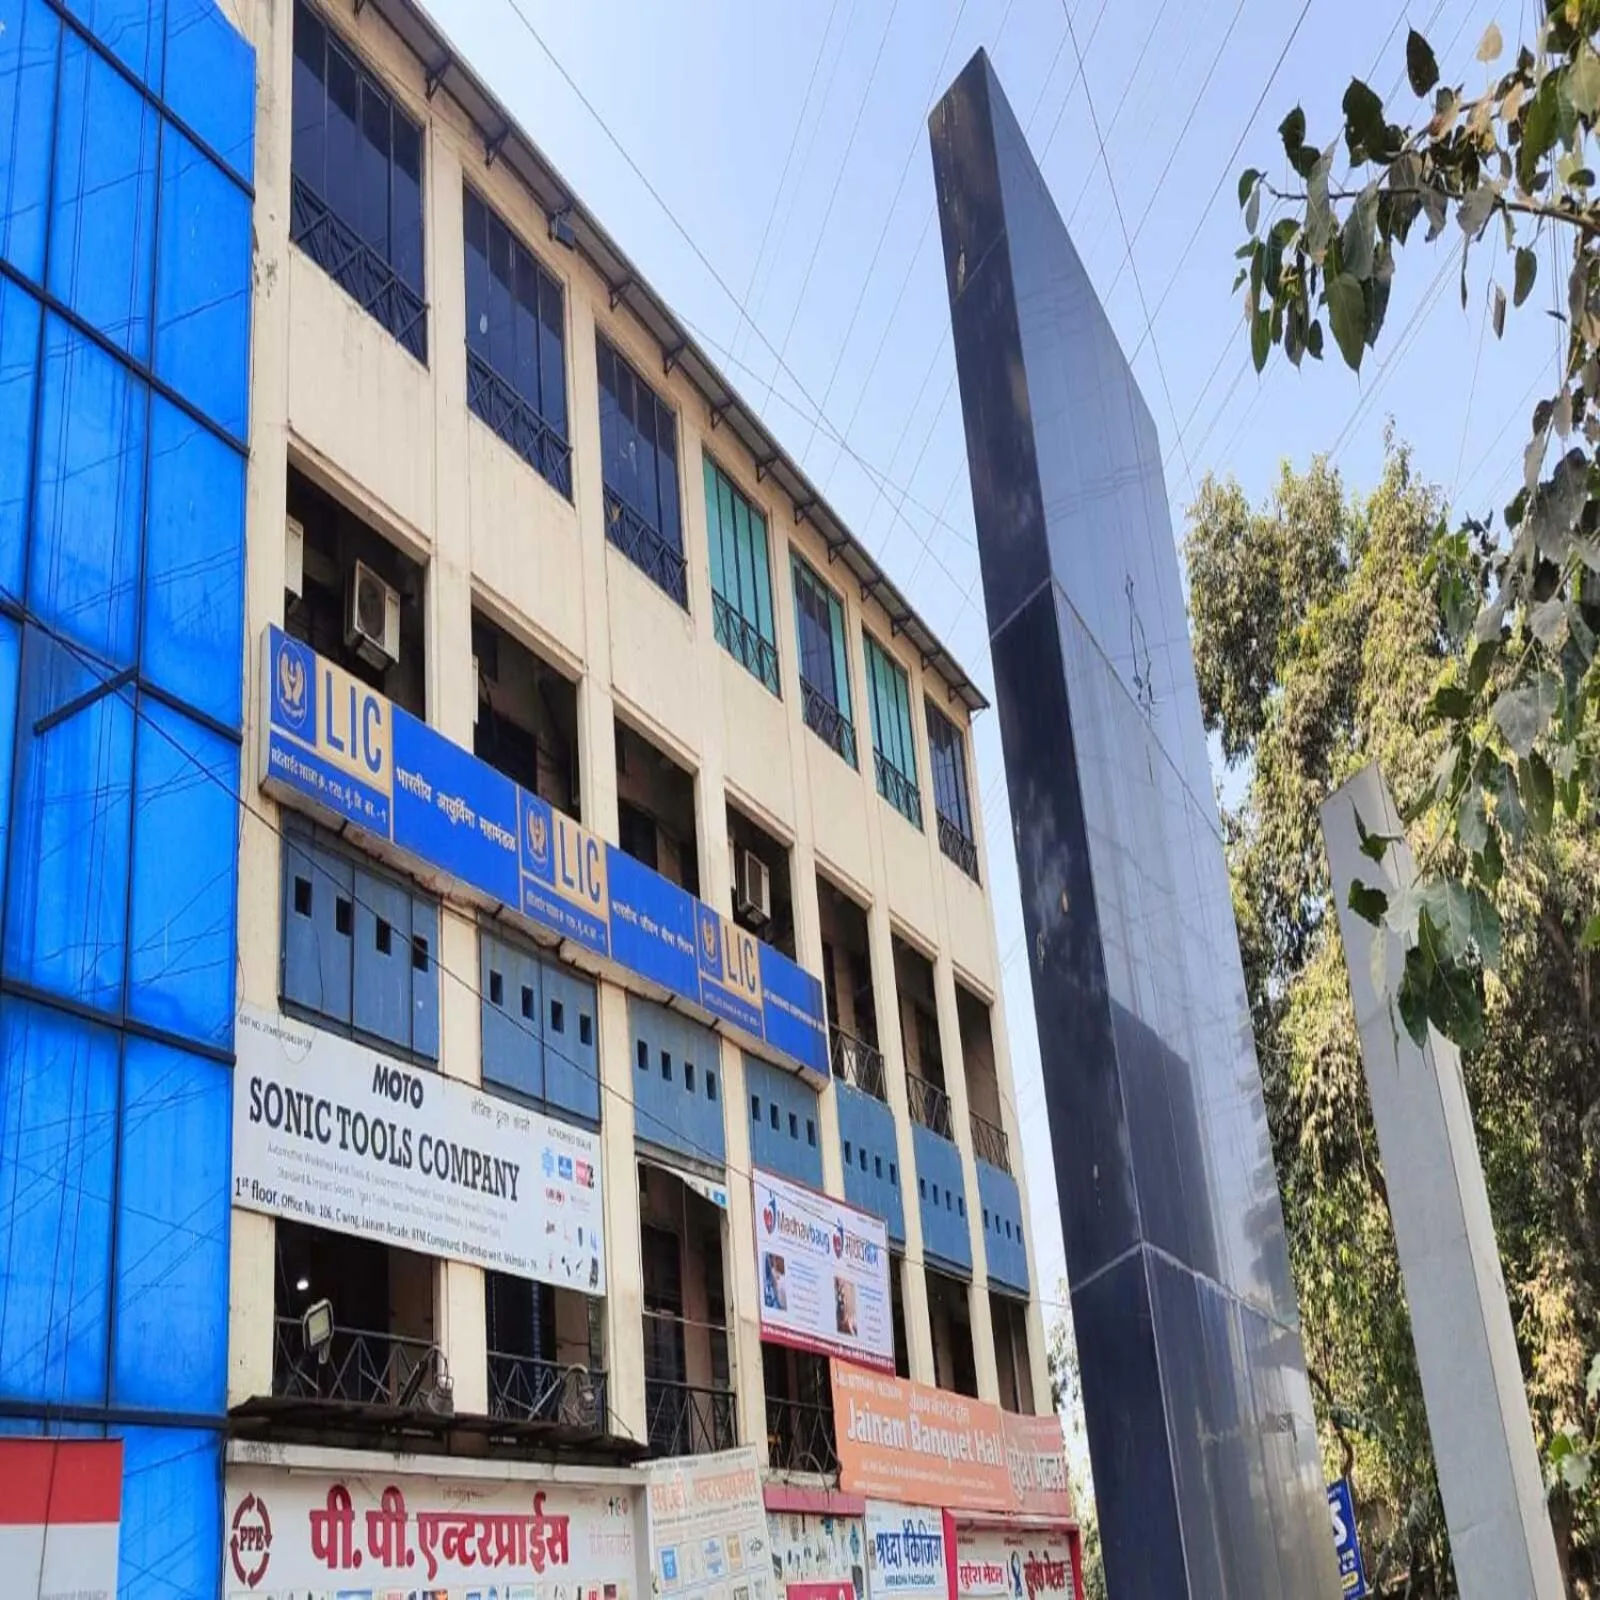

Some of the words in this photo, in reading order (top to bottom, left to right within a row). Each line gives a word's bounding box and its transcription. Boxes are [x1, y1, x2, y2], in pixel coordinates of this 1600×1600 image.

[326, 670, 382, 774] LIC
[559, 820, 600, 904] LIC
[723, 924, 756, 992] LIC
[373, 1063, 424, 1109] MOTO
[249, 1076, 332, 1144] SONIC
[336, 1105, 412, 1169] TOOLS
[419, 1134, 520, 1201] COMPANY
[281, 1193, 302, 1212] Office
[848, 1398, 908, 1448] Jainam
[909, 1413, 974, 1468] Banquet
[975, 1429, 1003, 1467] Hall
[238, 1525, 264, 1553] PPE
